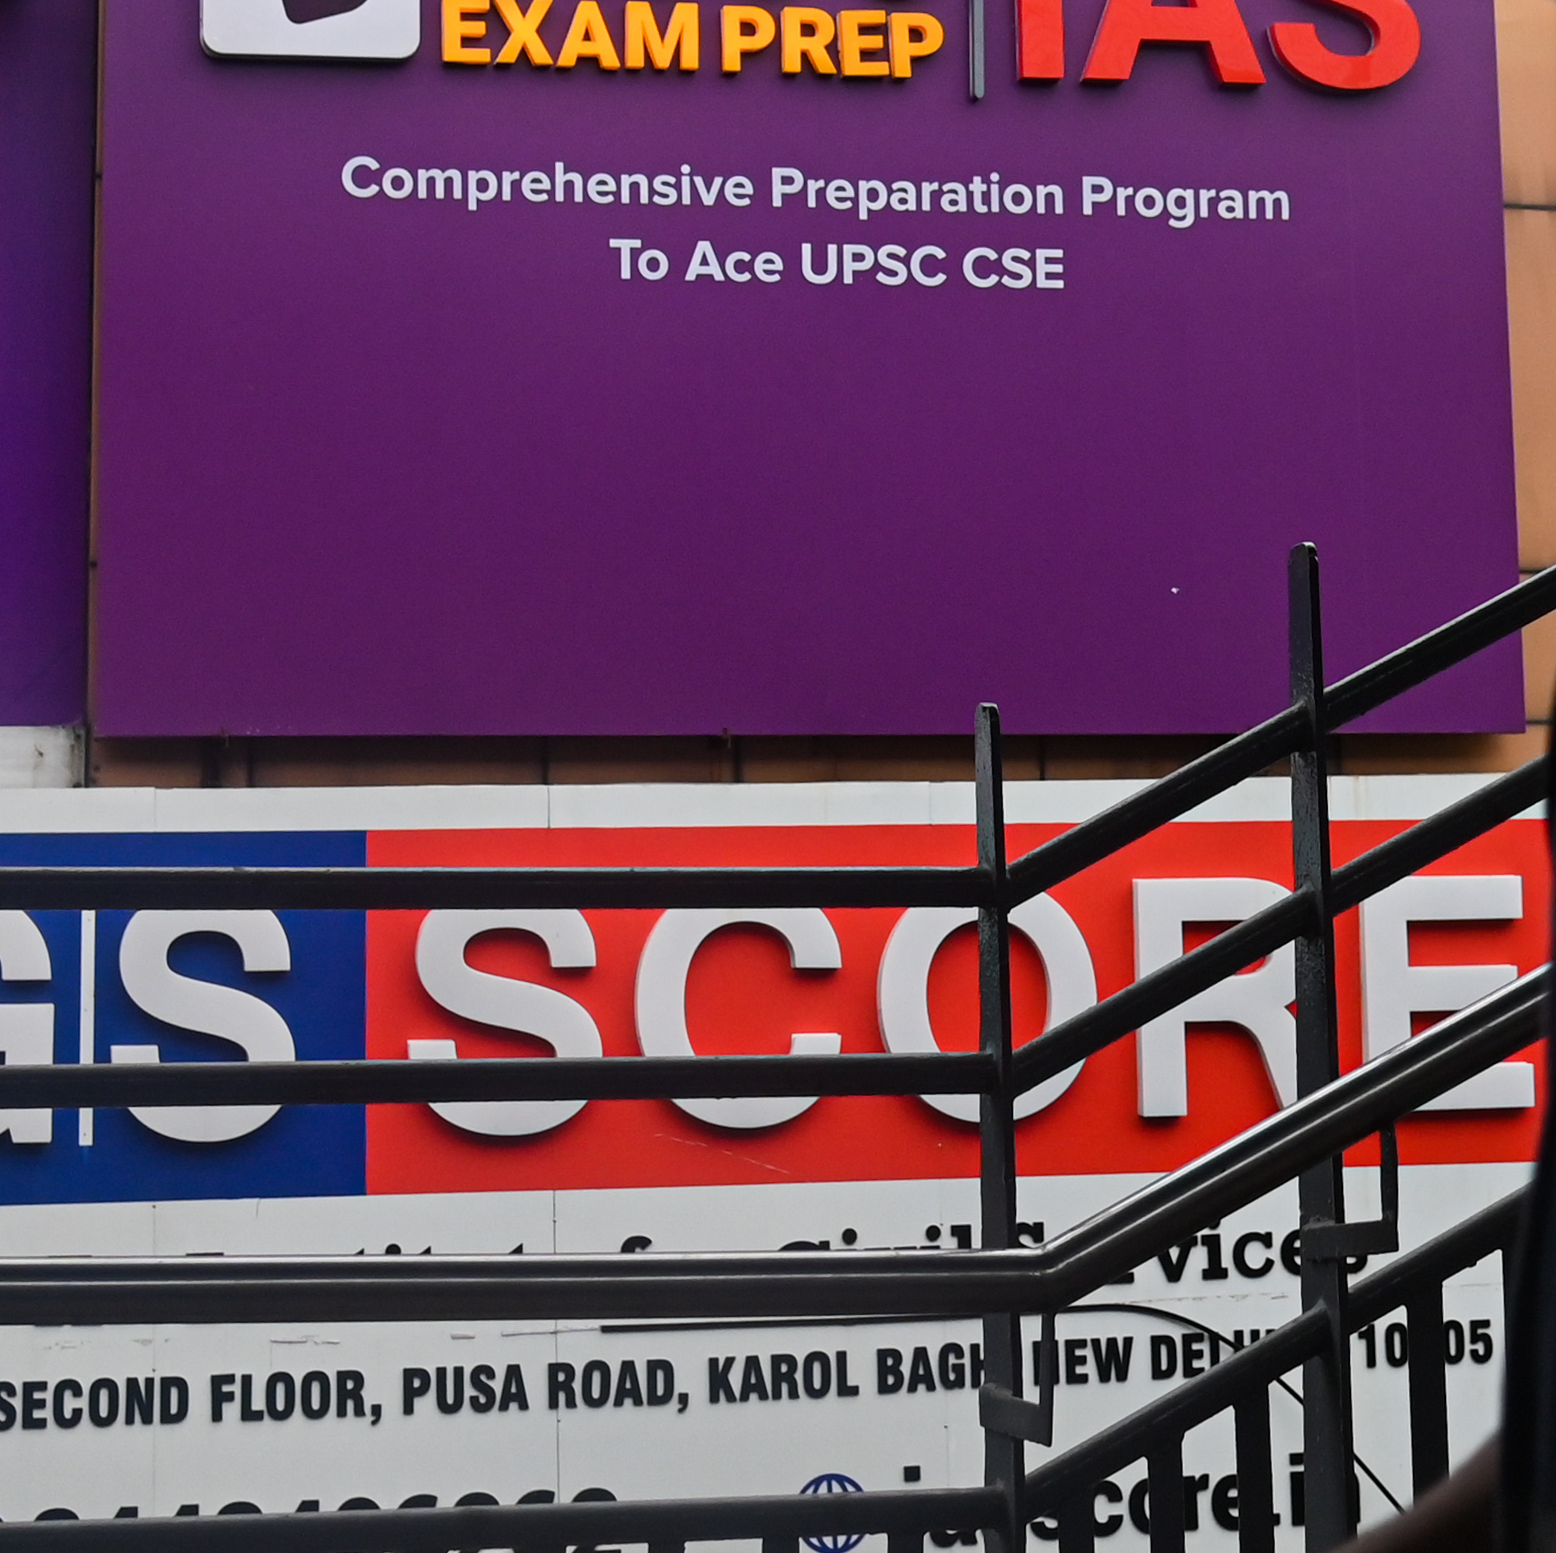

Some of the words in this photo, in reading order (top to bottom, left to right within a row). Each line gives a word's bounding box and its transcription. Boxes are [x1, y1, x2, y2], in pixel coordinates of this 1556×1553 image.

[721, 5, 944, 78] PREP
[341, 155, 753, 211] Comprehensive
[771, 167, 1064, 219] Preparation
[1081, 176, 1291, 228] Program
[610, 239, 669, 281] To
[685, 241, 783, 284] Ace
[801, 244, 947, 289] UPSC
[962, 247, 1065, 290] CSE
[407, 873, 1534, 1137] SCORE
[210, 1370, 384, 1427] FLOOR,
[402, 1364, 529, 1415] PUSA
[546, 1358, 690, 1415] ROAD,
[708, 1347, 860, 1405] KAROL
